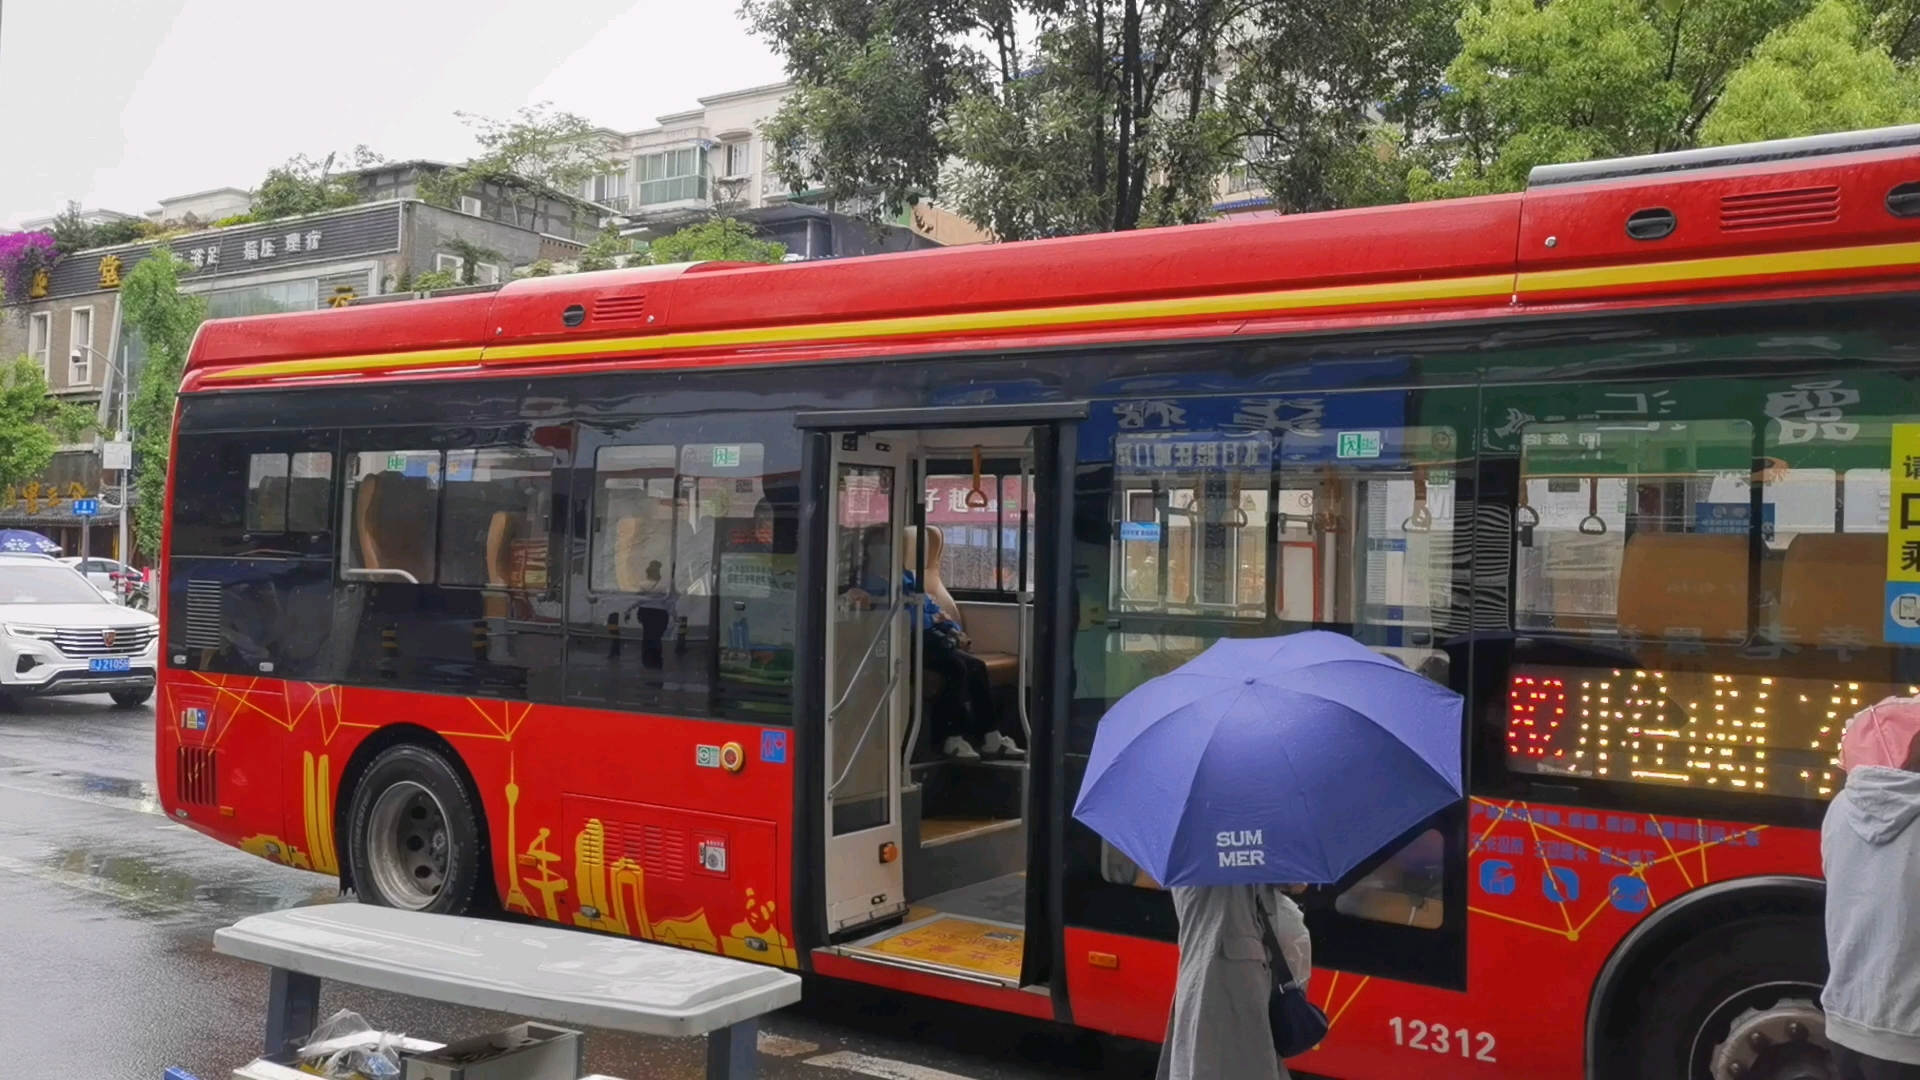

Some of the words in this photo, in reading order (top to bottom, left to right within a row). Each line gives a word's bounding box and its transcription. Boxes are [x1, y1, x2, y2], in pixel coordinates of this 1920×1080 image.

[1216, 829, 1263, 847] SUM
[1218, 850, 1266, 868] MER
[1389, 1016, 1497, 1063] 12312
